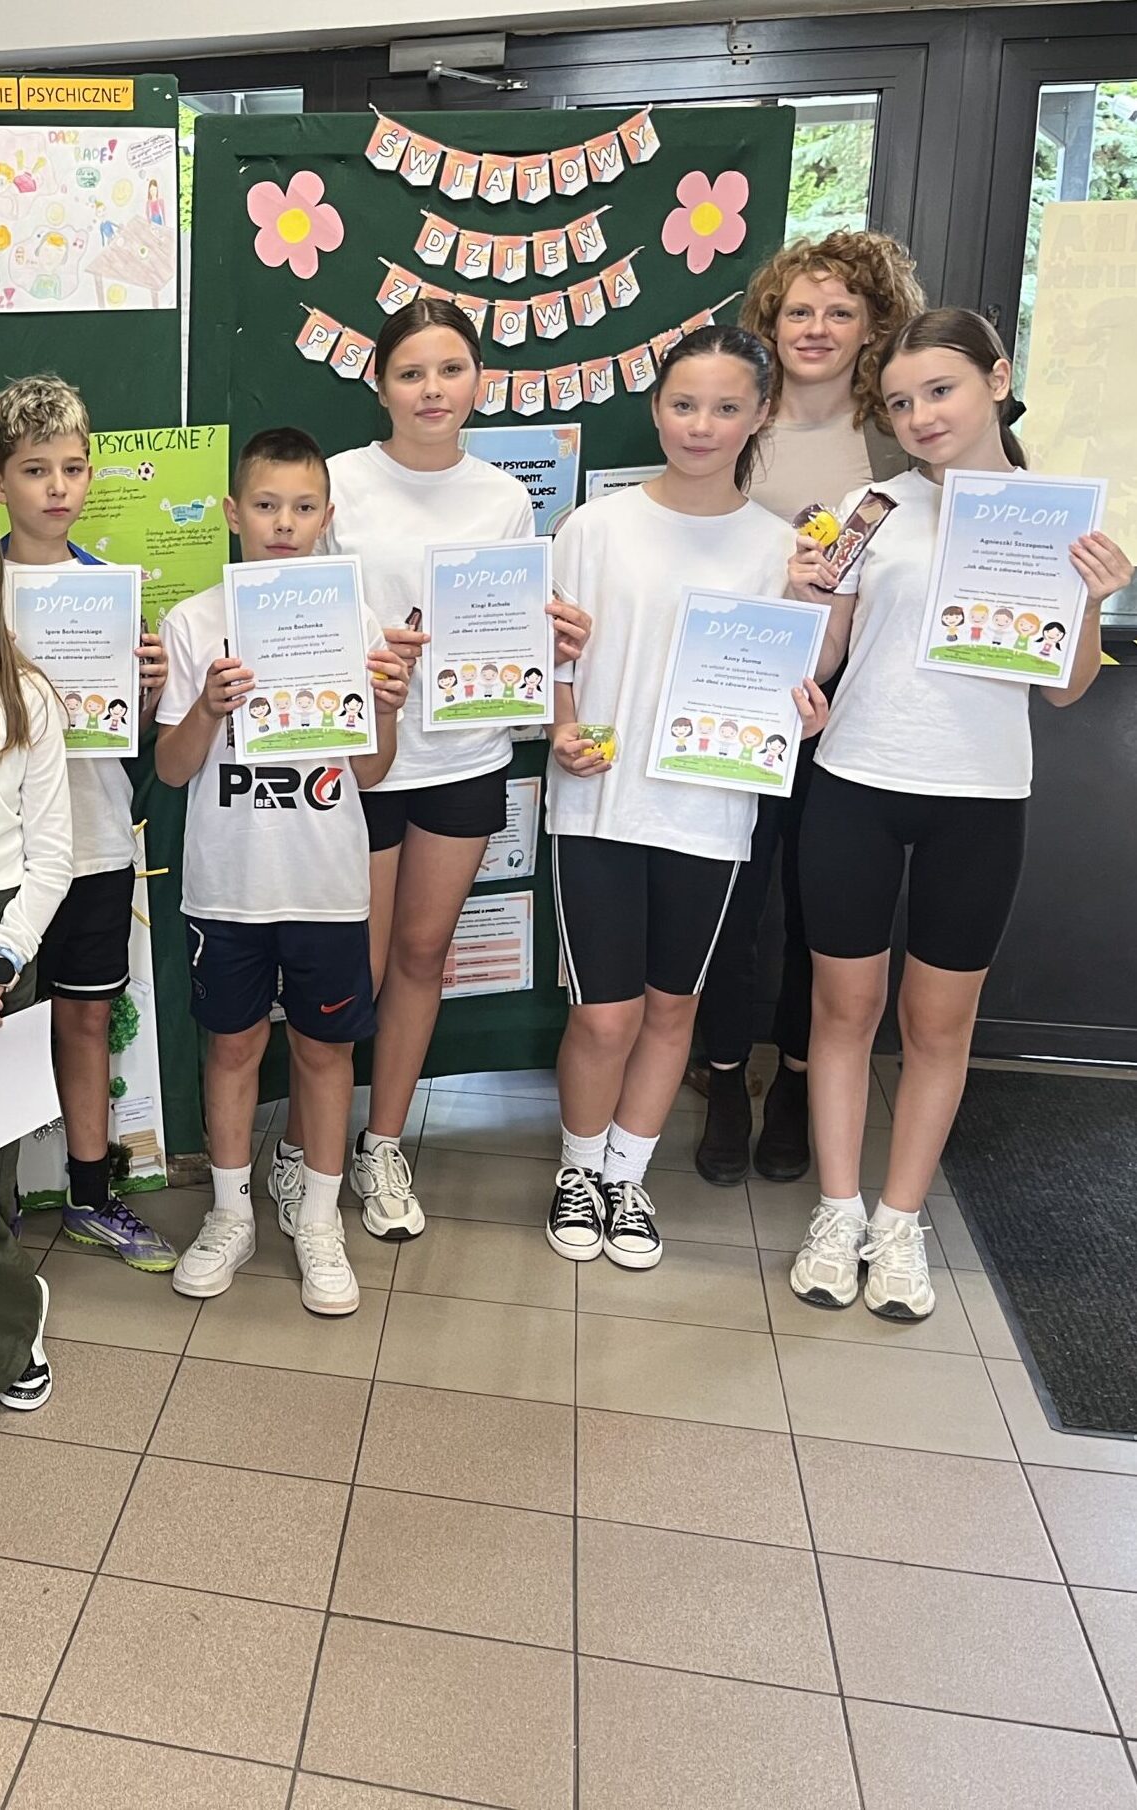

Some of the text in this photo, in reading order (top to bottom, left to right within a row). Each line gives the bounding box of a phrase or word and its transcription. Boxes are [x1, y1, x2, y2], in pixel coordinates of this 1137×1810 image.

[376, 125, 648, 192] ŚWIATOWY
[424, 222, 599, 270] DZIEŃ
[387, 274, 632, 335] ZOWIA
[309, 326, 703, 405] PSICZNE
[94, 429, 201, 454] PSYCHICZNE
[974, 504, 1069, 526] DYPLOM
[453, 568, 528, 590] DYPLOM
[34, 595, 114, 614] DYPLOM
[257, 586, 339, 610] DYPLOM
[705, 620, 793, 646] DYPLOM
[255, 799, 272, 808] BE
